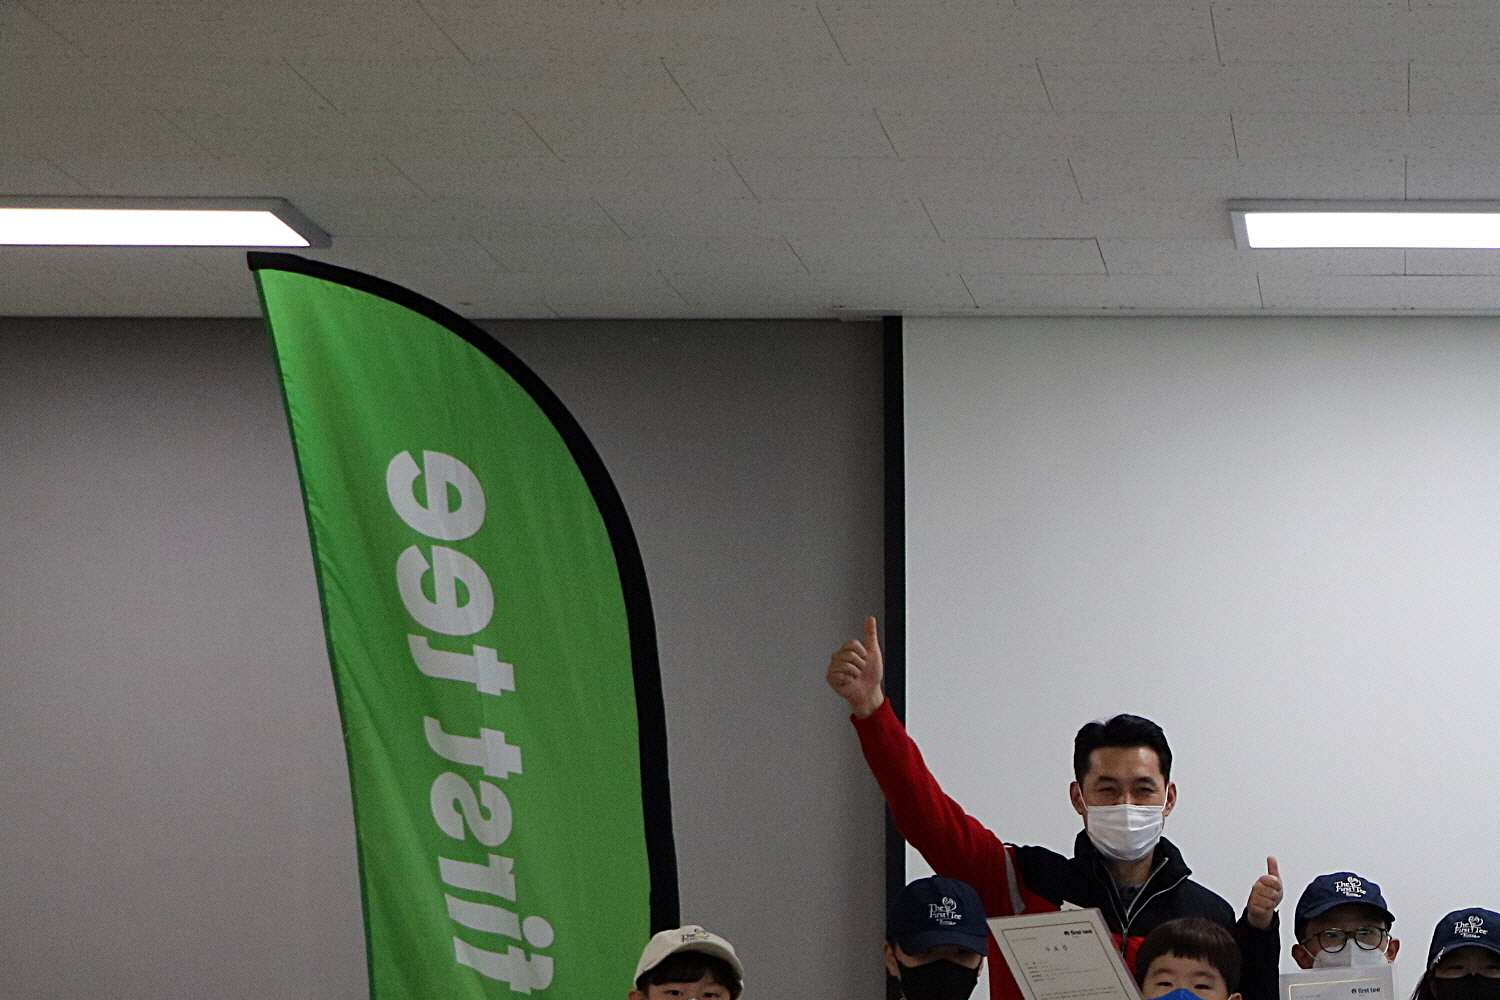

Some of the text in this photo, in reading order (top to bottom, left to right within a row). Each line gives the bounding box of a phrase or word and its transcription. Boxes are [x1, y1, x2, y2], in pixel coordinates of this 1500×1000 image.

[929, 903, 944, 911] The
[930, 909, 962, 920] First Tee
[1454, 921, 1469, 929] The
[1474, 927, 1488, 935] Tee
